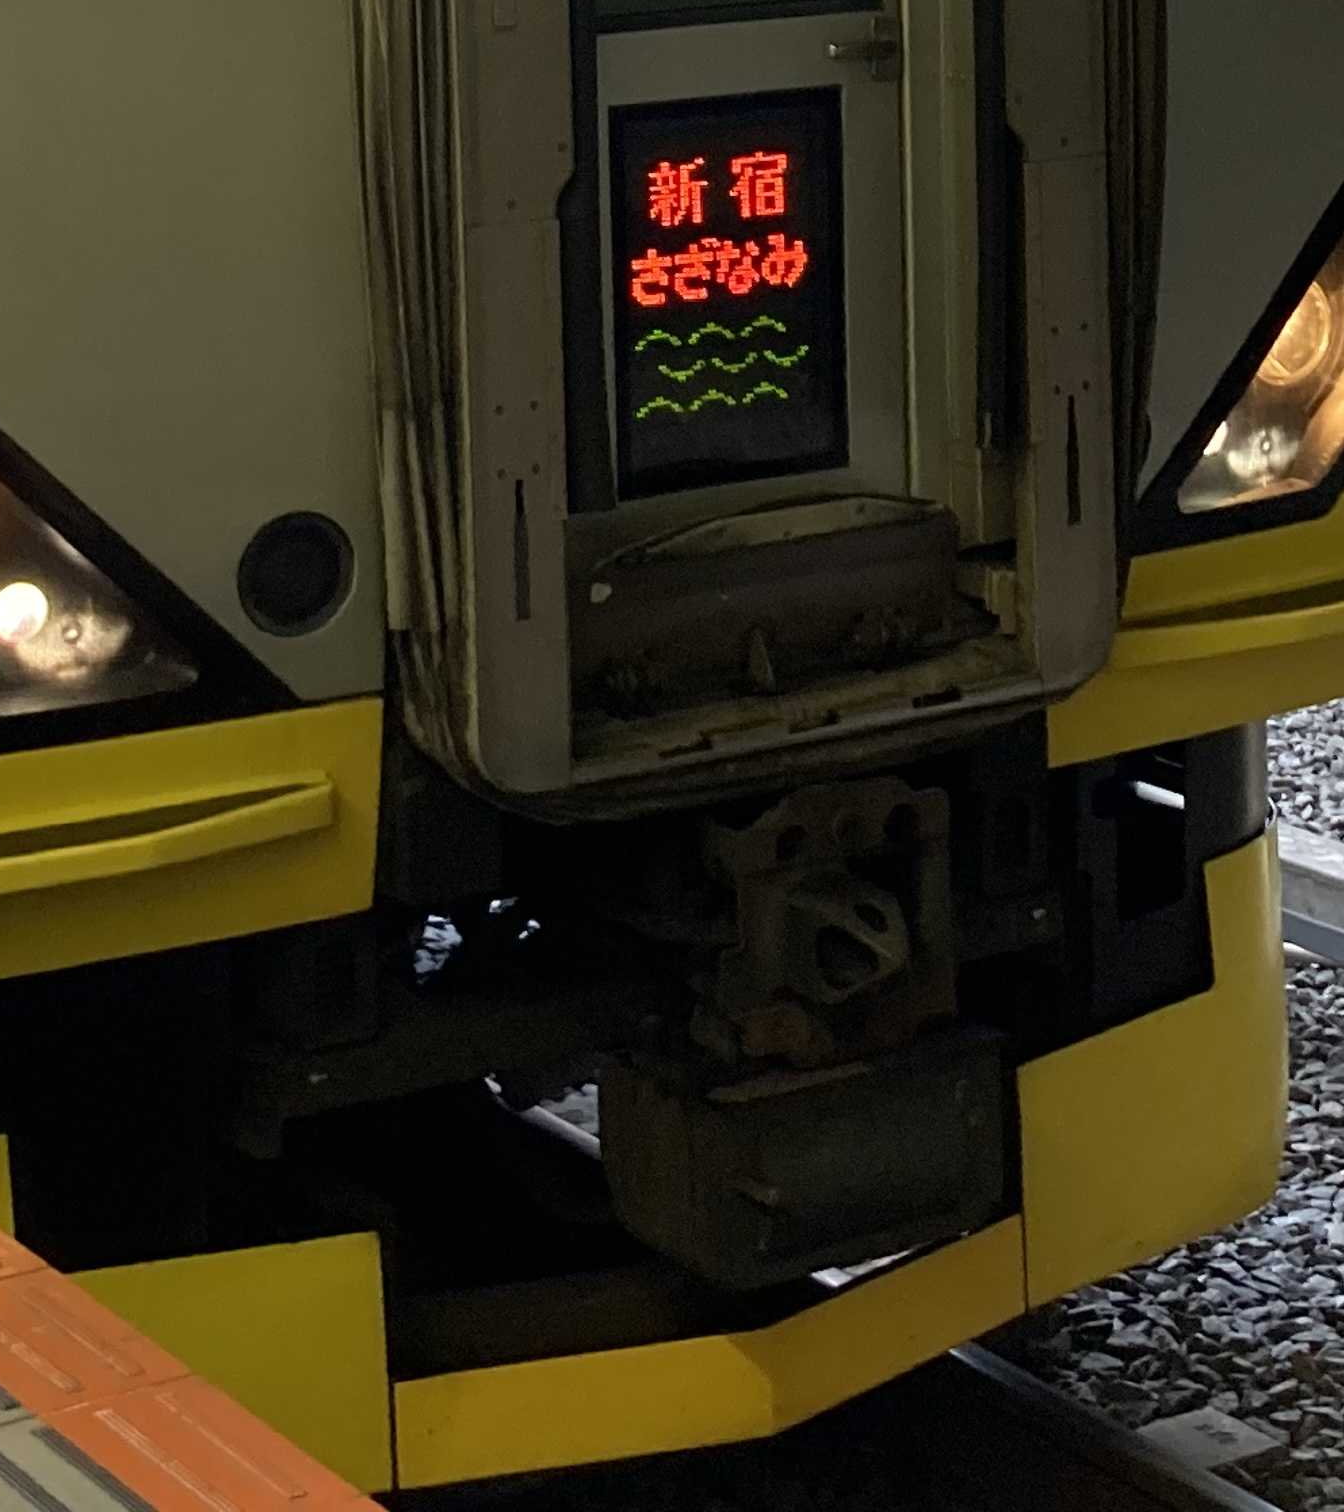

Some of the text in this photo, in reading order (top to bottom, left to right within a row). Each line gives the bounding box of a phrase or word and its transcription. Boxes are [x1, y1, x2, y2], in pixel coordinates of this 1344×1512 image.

[648, 151, 788, 227] 新宿
[631, 233, 808, 307] さざなみ
